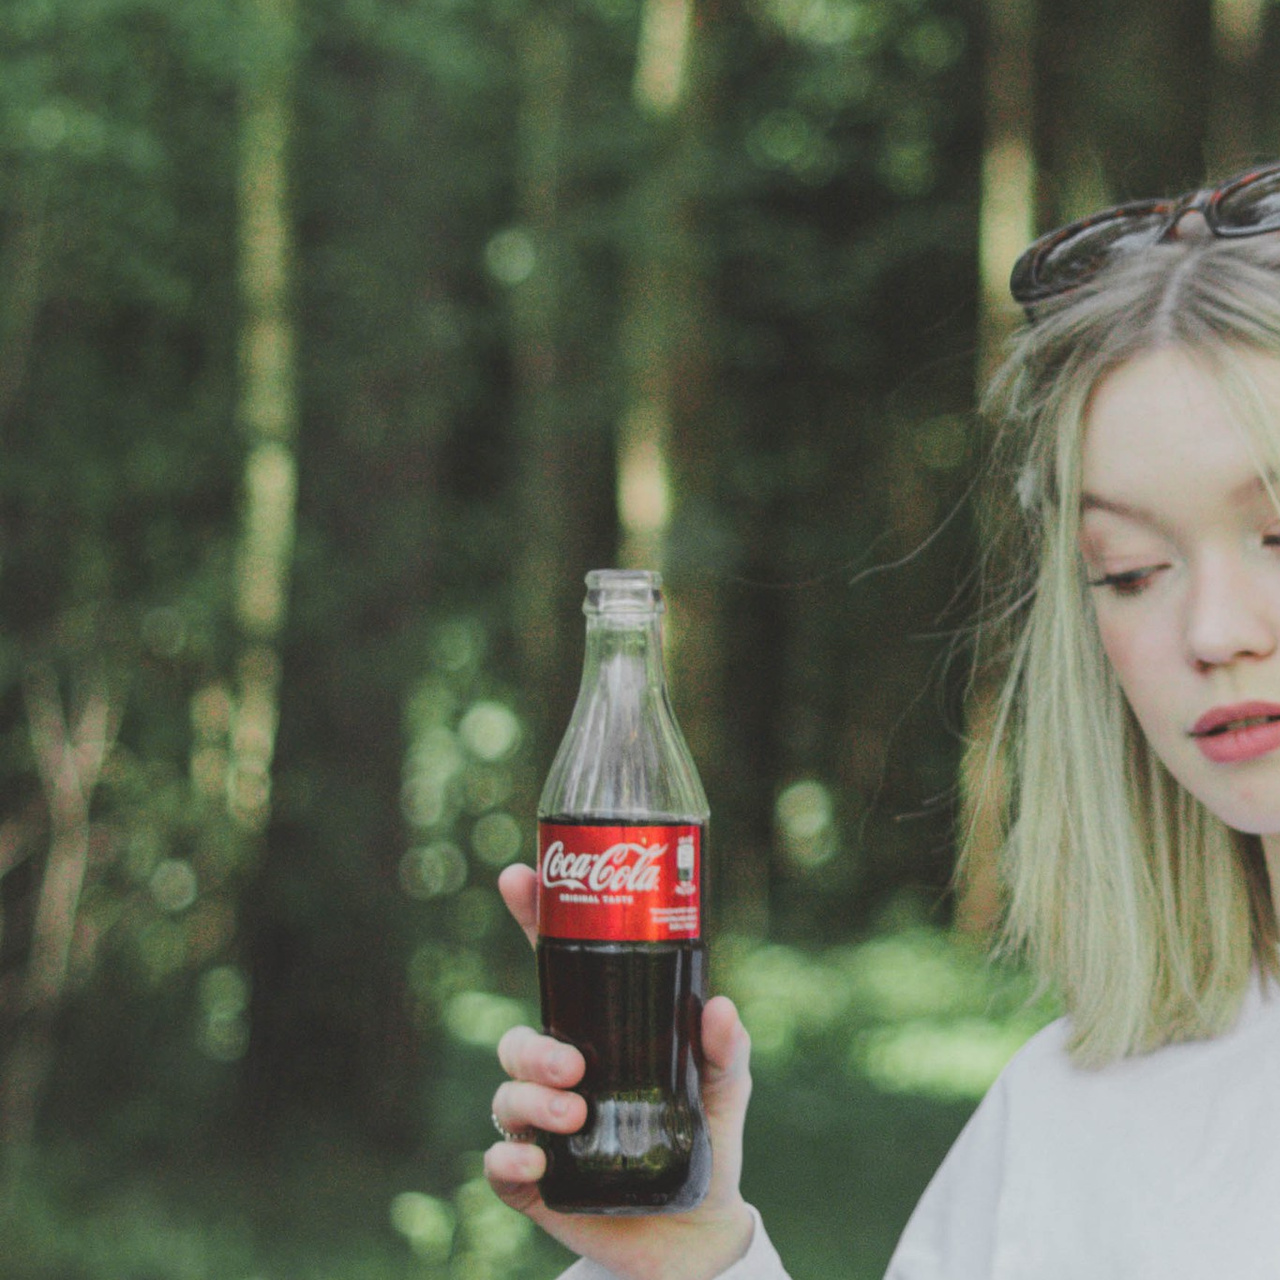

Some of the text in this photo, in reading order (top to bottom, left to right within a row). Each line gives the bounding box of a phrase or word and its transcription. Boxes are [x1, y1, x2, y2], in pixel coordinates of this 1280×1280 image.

[543, 841, 668, 891] Coca-Cola
[559, 893, 634, 904] ORIGINAL TASTE
